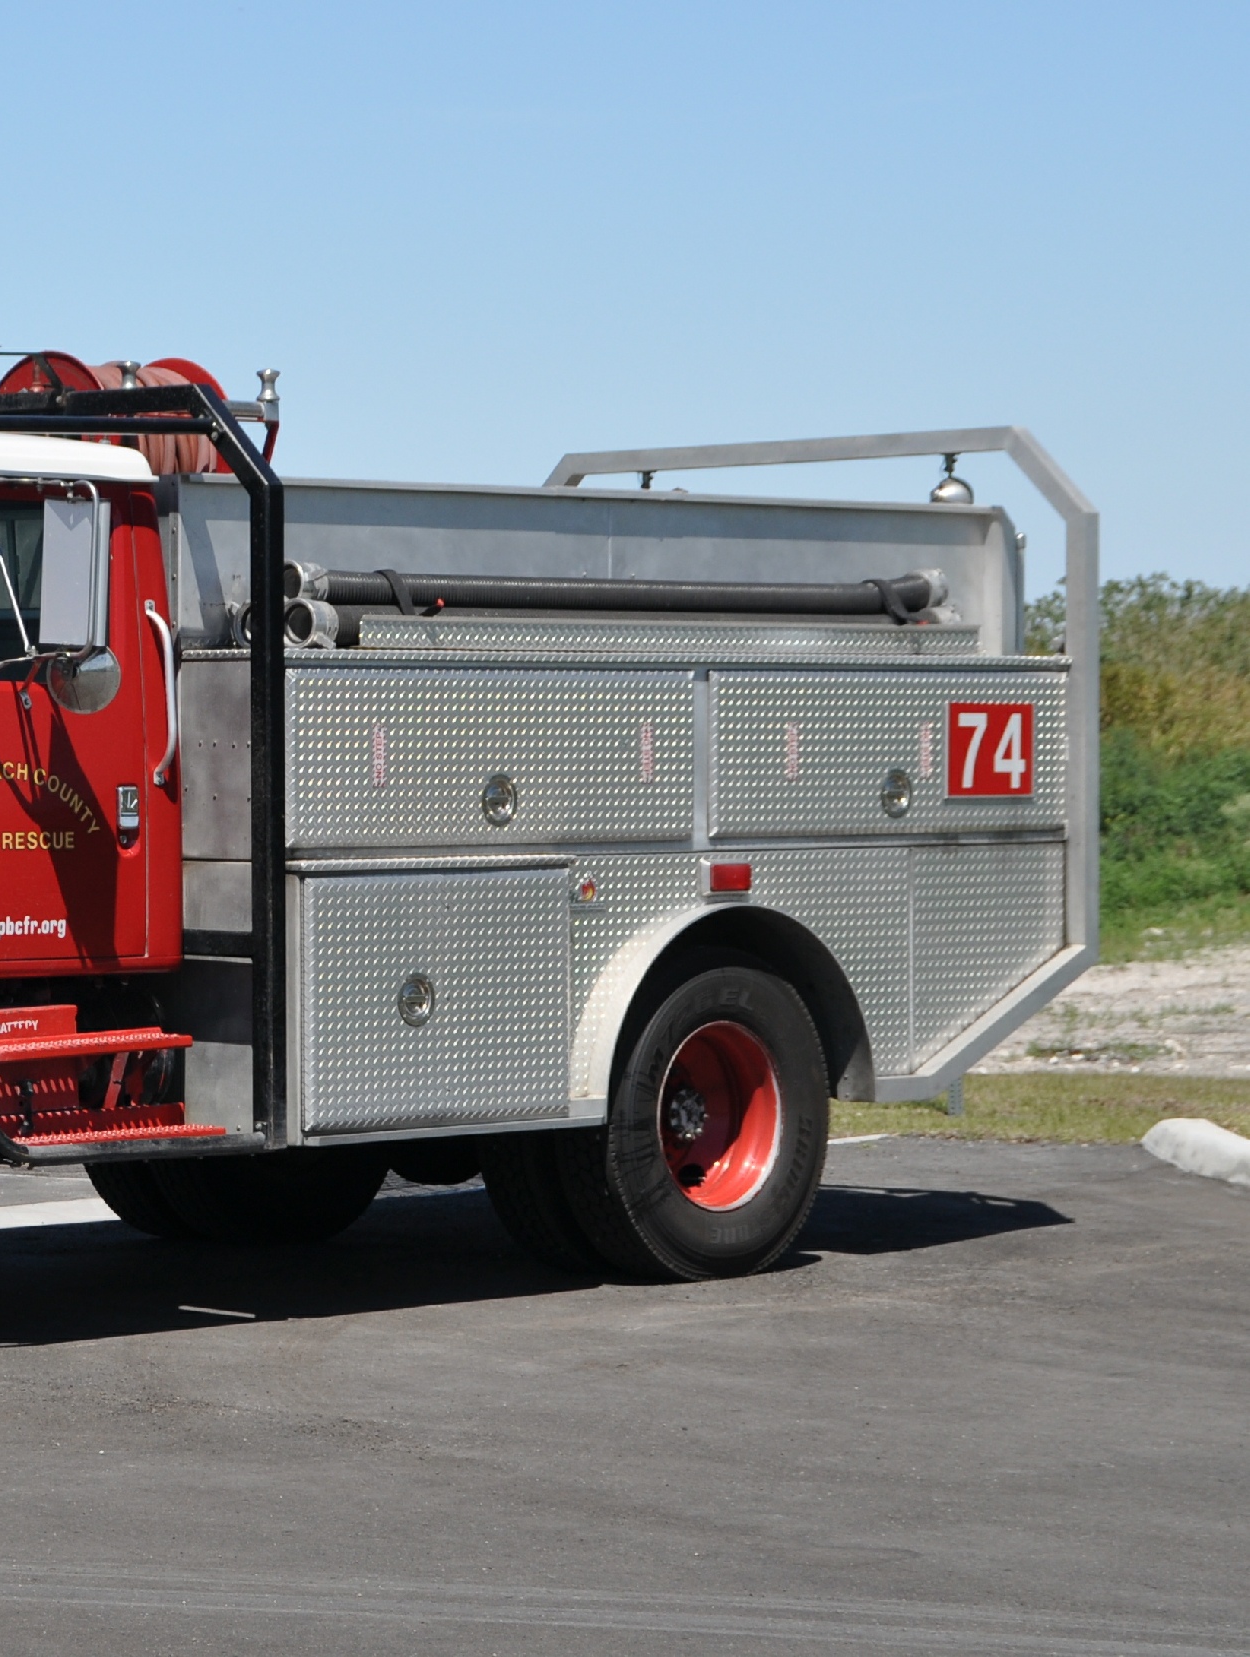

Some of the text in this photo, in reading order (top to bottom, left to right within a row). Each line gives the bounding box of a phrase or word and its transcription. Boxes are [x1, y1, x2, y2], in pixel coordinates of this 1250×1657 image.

[375, 732, 383, 760] STEP
[957, 712, 1027, 790] 74
[34, 768, 100, 835] COUNTY
